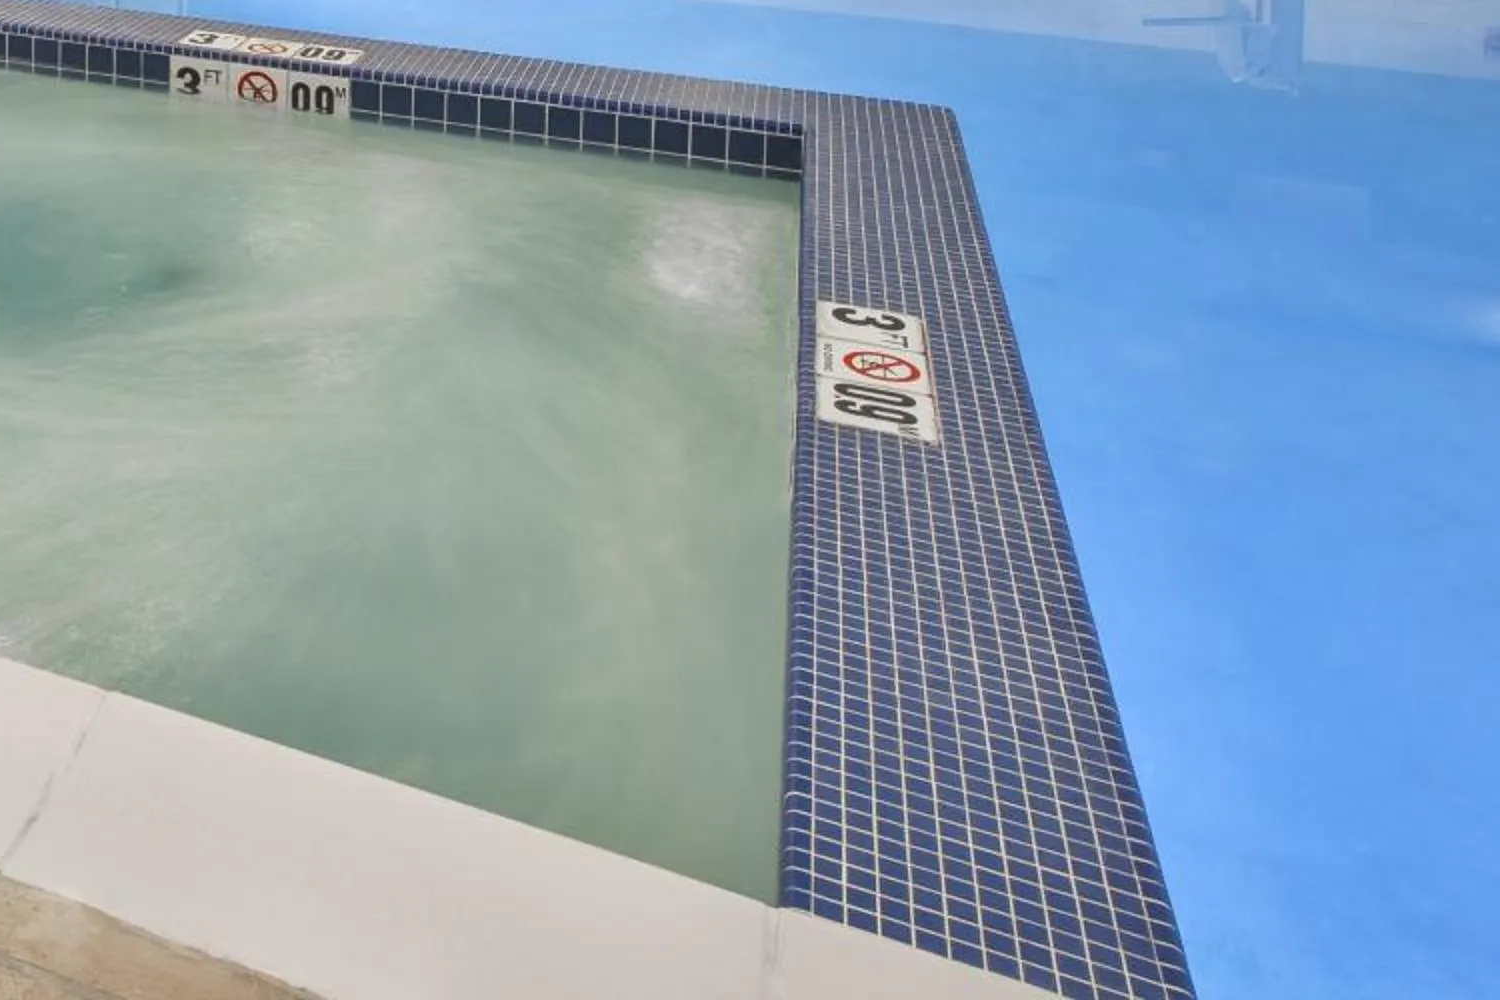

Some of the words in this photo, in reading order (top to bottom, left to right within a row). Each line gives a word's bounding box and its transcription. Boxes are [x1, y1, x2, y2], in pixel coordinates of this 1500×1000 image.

[176, 67, 201, 95] 3
[204, 69, 222, 85] FT
[832, 307, 906, 331] 3
